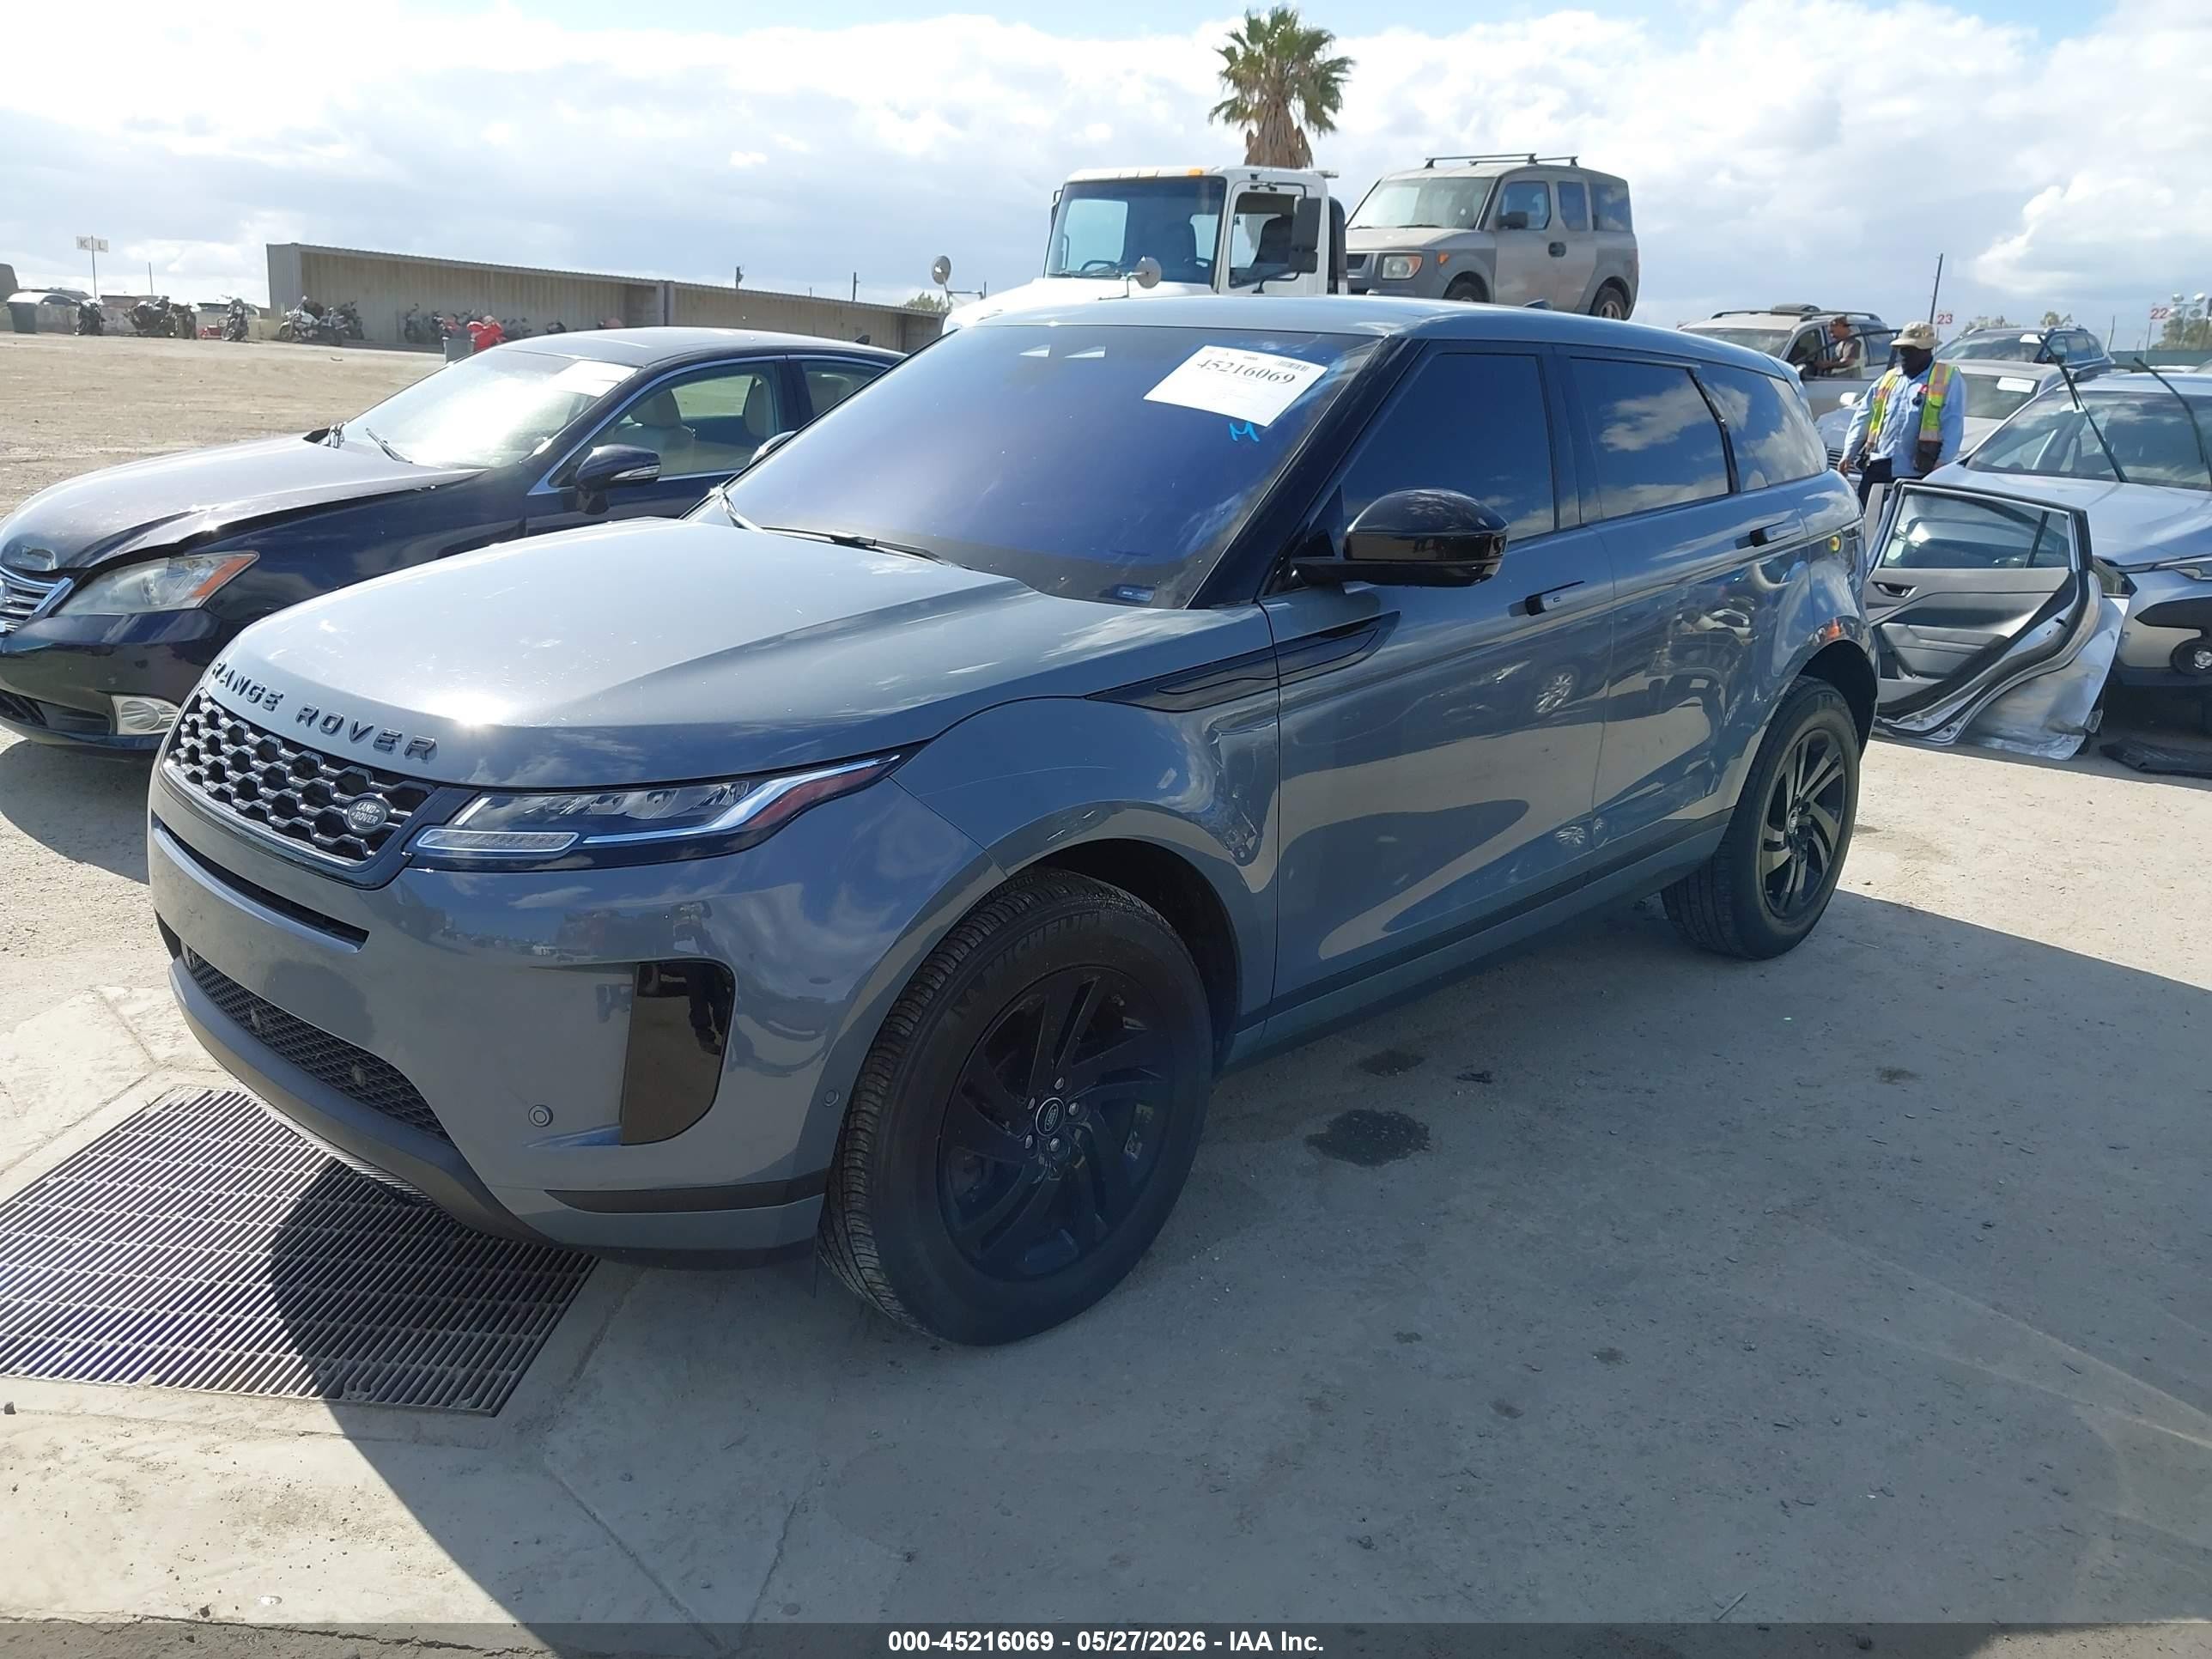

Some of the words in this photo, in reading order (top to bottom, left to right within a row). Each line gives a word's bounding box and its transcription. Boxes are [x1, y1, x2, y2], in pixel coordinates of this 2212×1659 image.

[80, 239, 88, 248] K
[98, 240, 105, 250] L
[1937, 313, 1953, 325] 23
[2150, 307, 2168, 319] 22
[1197, 359, 1296, 385] 45216069
[212, 660, 284, 713] RANGE
[295, 702, 437, 764] ROVER
[356, 802, 377, 814] LAND
[353, 811, 379, 825] ROVER
